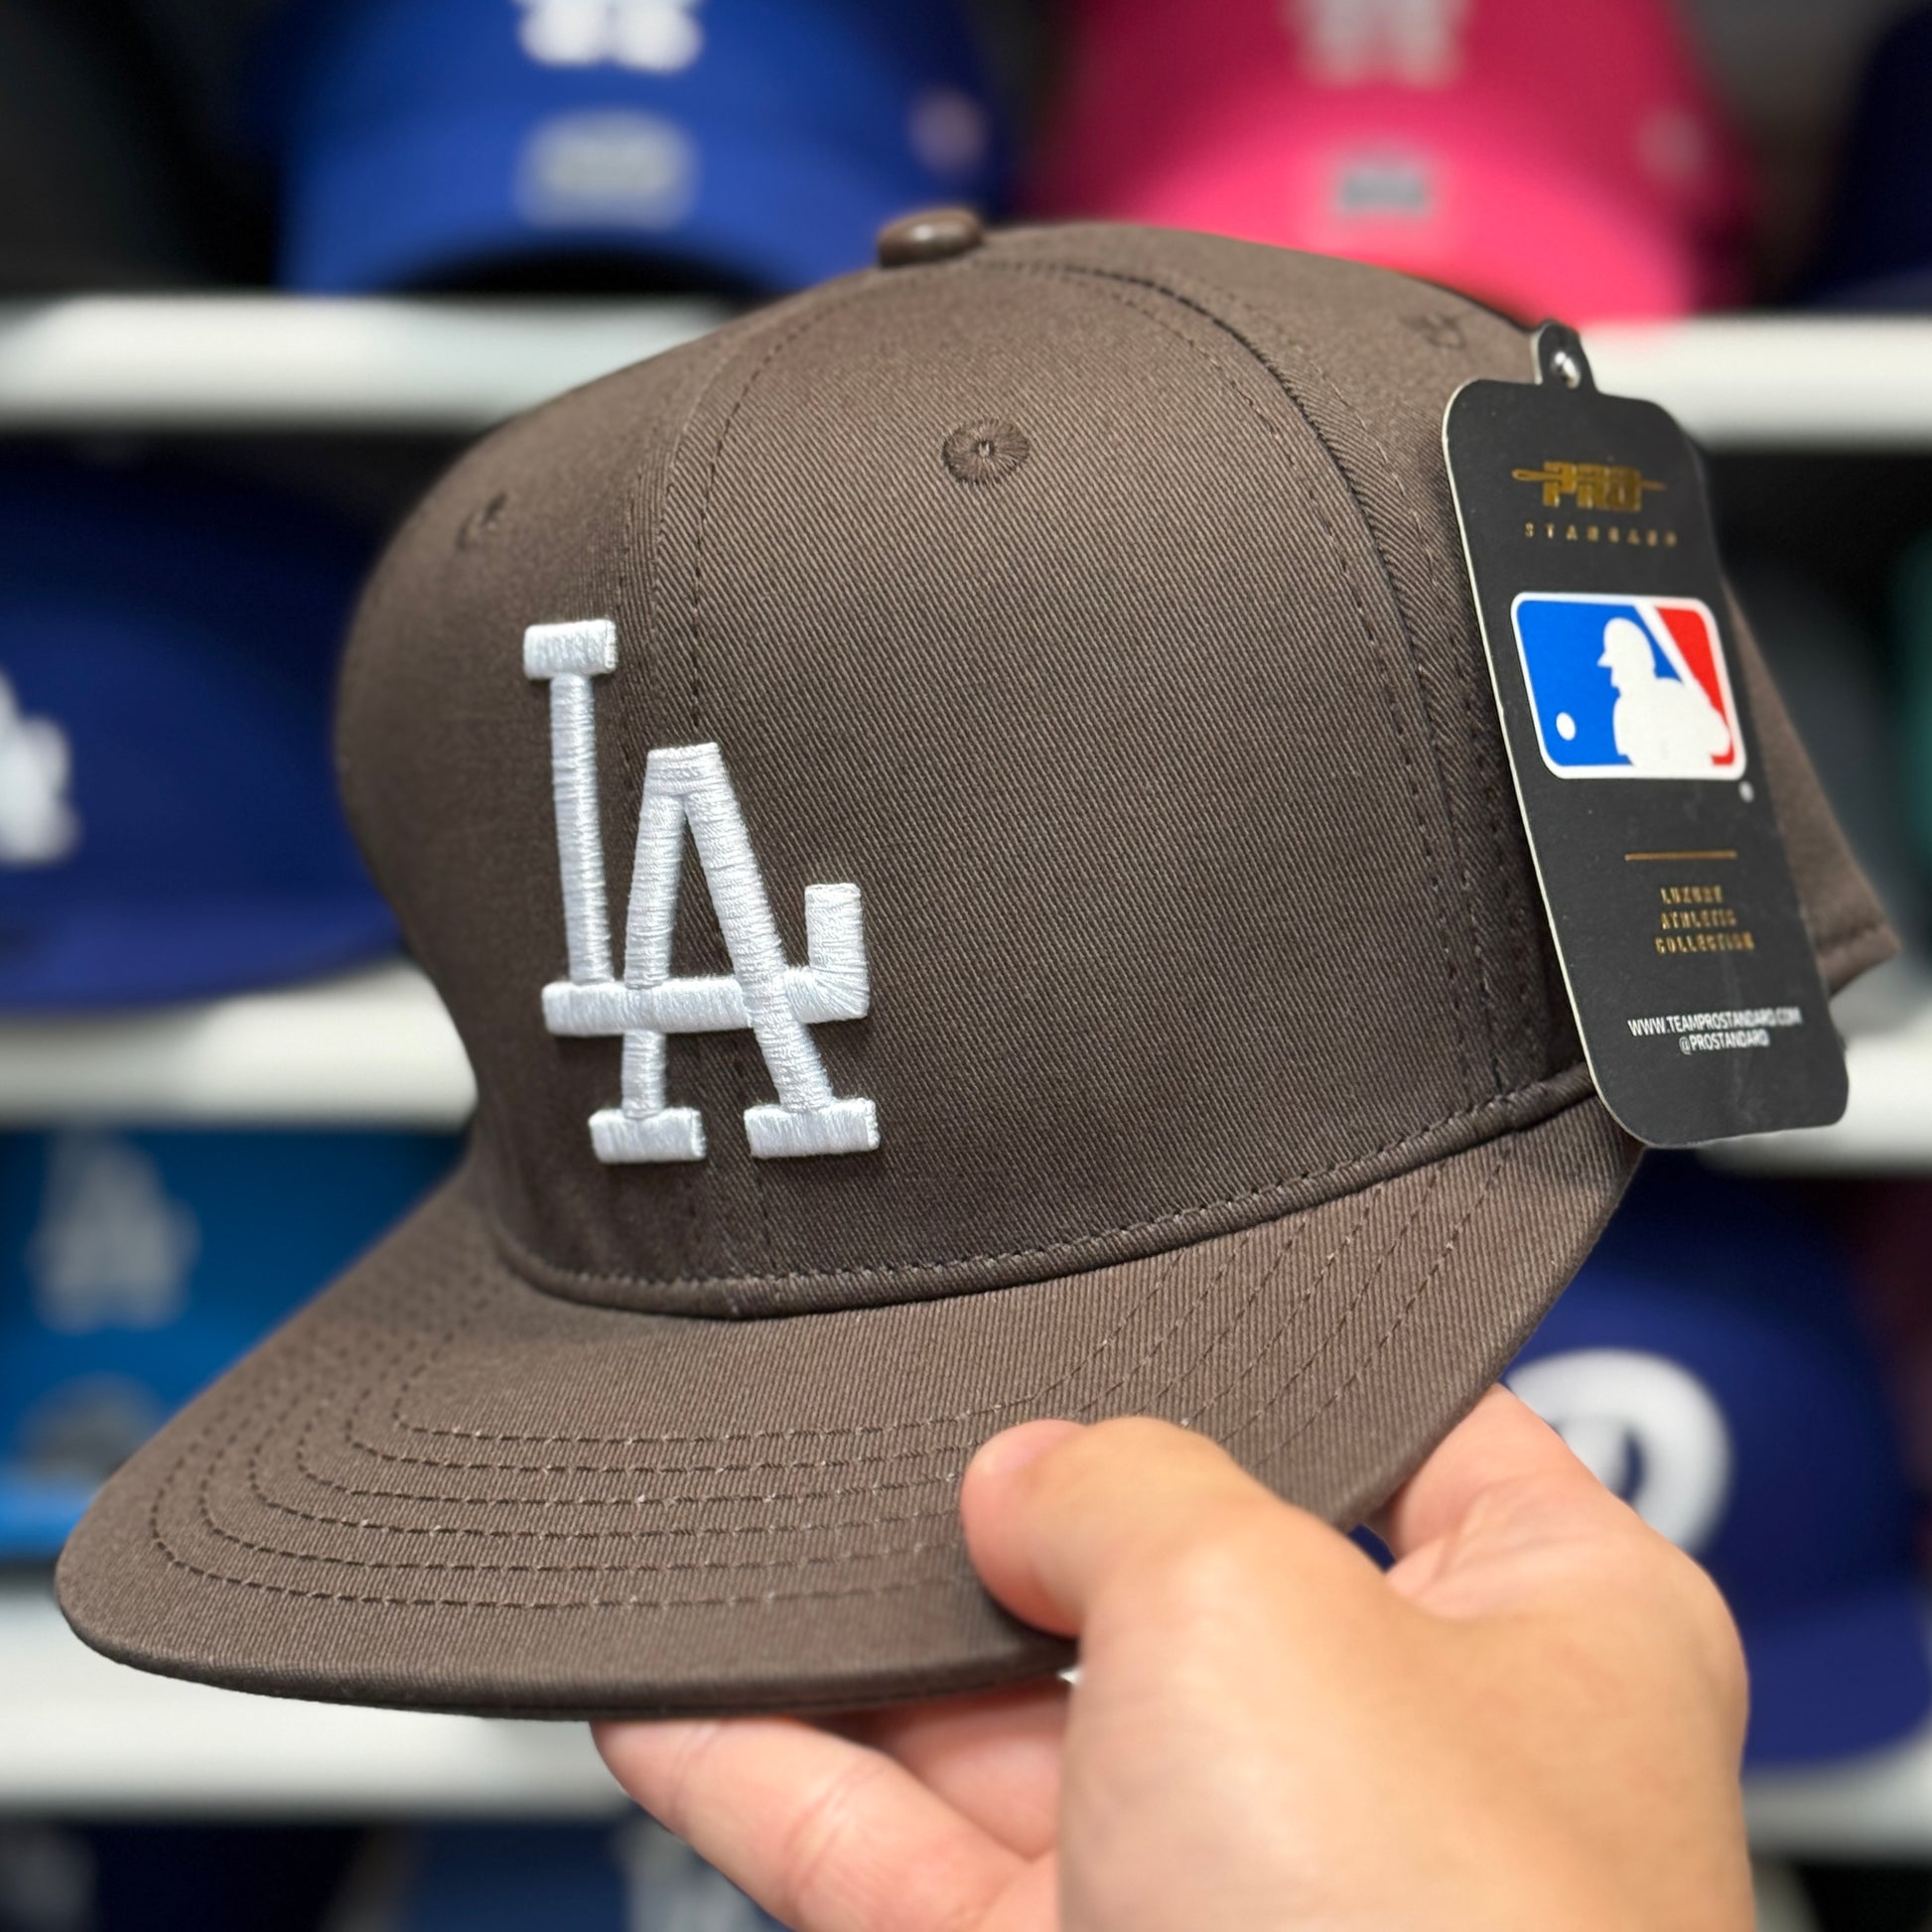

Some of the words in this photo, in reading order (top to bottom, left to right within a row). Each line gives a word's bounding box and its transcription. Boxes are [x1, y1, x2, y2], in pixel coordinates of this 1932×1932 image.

[523, 619, 880, 1164] LA
[1627, 1006, 1803, 1036] WWW.TEAMPROSTANDARD.COM
[1679, 1028, 1771, 1055] @PROSTANDARD
